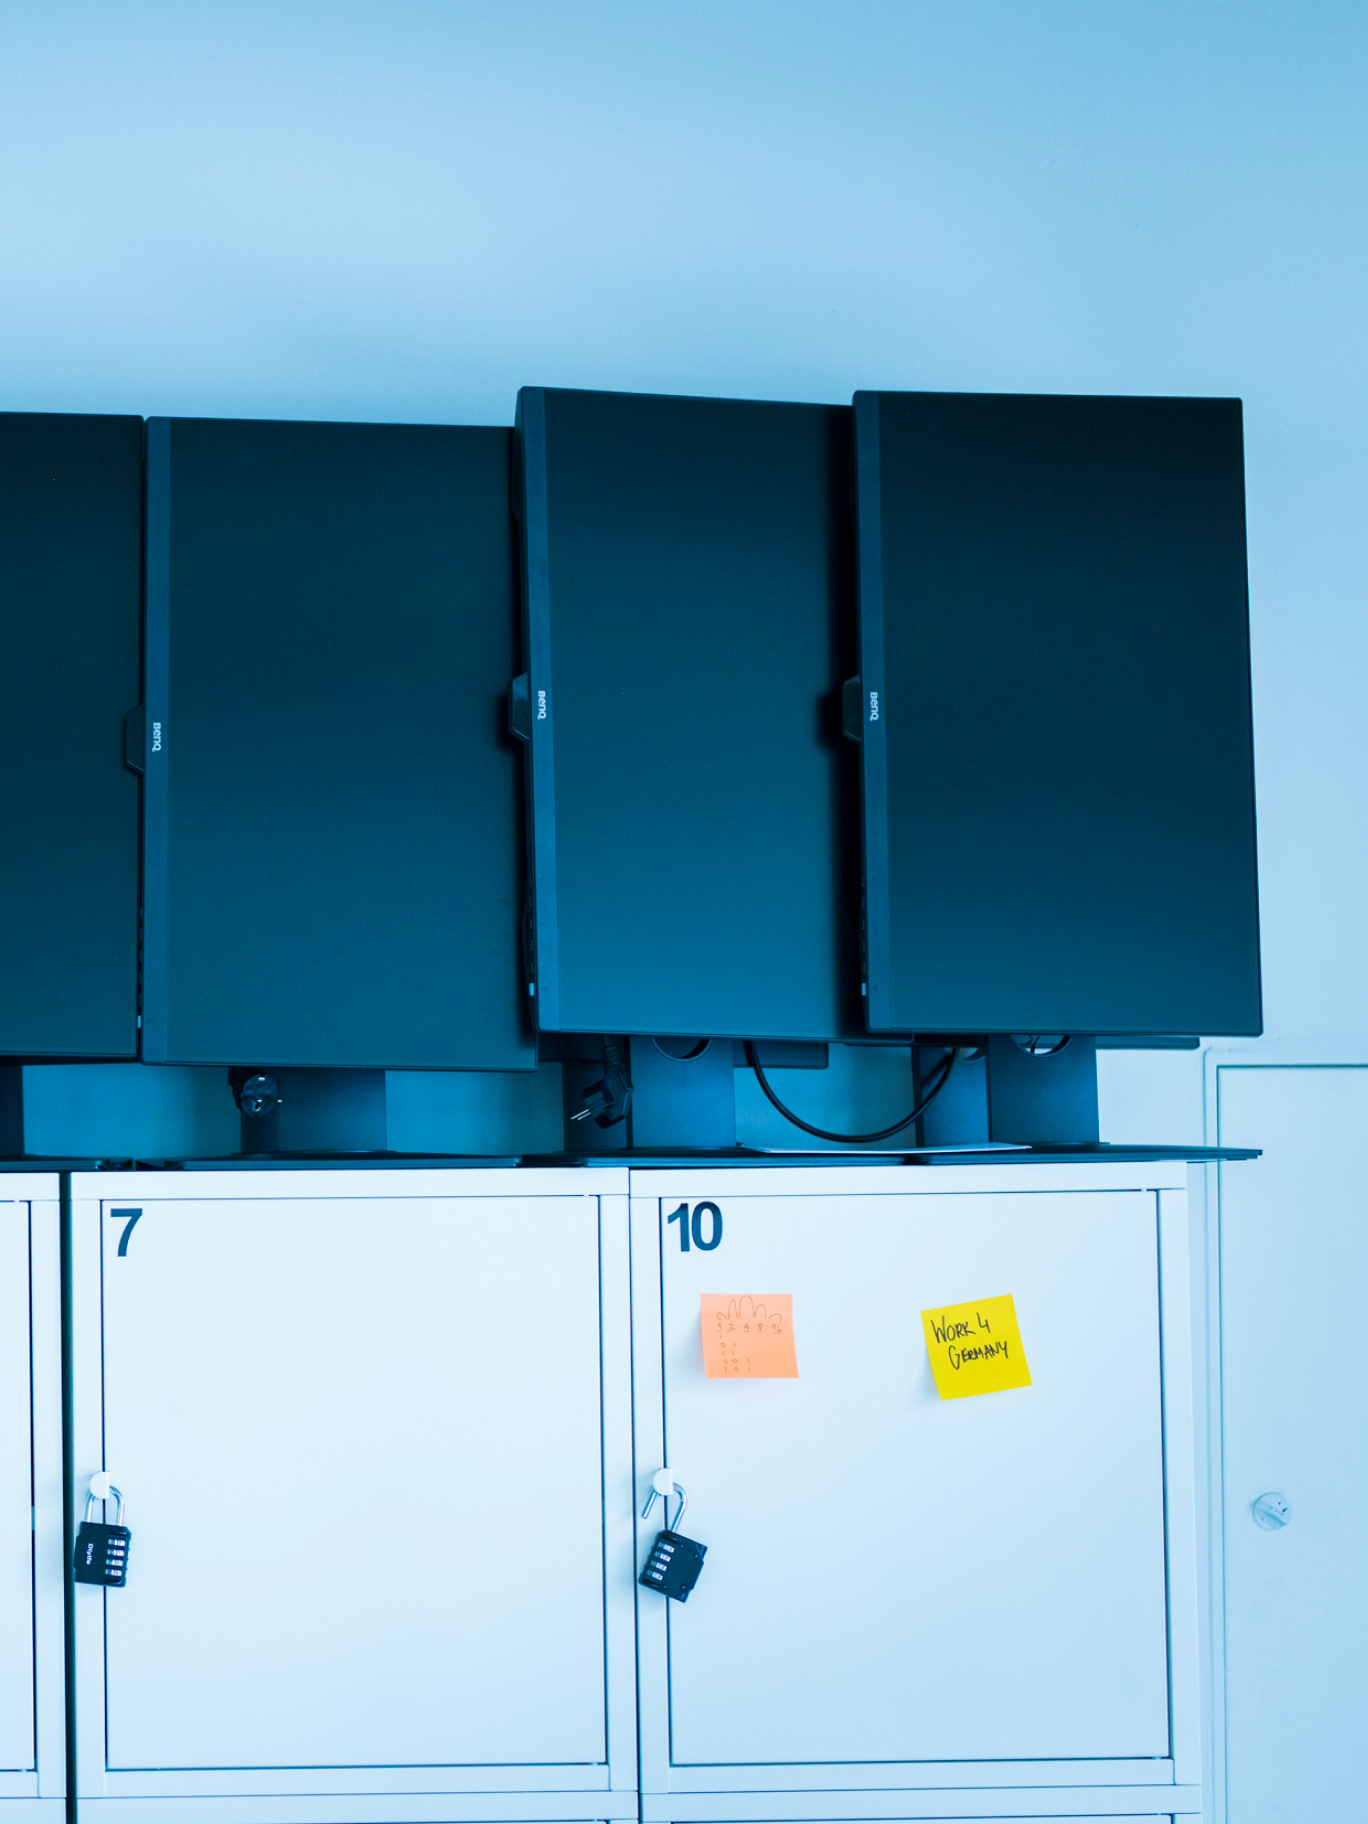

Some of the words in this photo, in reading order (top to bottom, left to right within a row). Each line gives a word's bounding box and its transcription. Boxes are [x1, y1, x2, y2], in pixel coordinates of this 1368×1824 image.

[537, 690, 547, 720] BenQ
[869, 691, 879, 722] BenQ
[151, 722, 162, 753] BenQ
[110, 1208, 143, 1257] 7
[667, 1202, 723, 1252] 10
[976, 1312, 991, 1334] 4
